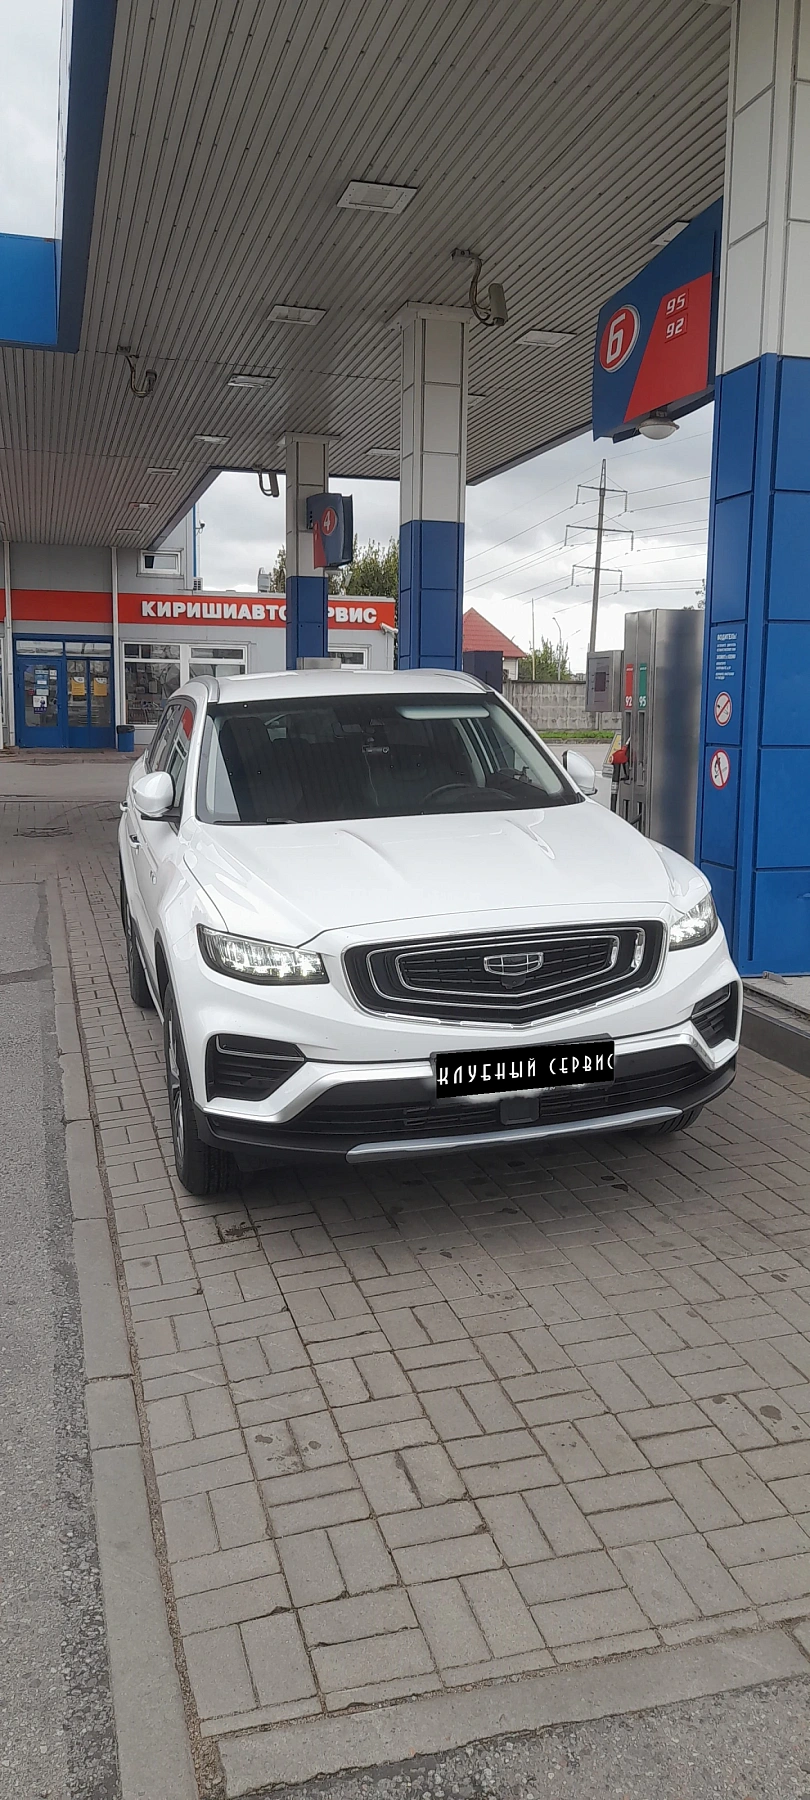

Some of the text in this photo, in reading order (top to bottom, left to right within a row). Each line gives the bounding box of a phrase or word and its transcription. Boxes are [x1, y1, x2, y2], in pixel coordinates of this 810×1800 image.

[666, 293, 686, 315] 95
[606, 313, 626, 364] 6
[666, 318, 684, 338] 92
[324, 510, 331, 532] 4
[141, 600, 377, 624] КИРИШИАВТОРВИС
[625, 695, 632, 707] 92
[639, 695, 646, 707] 95
